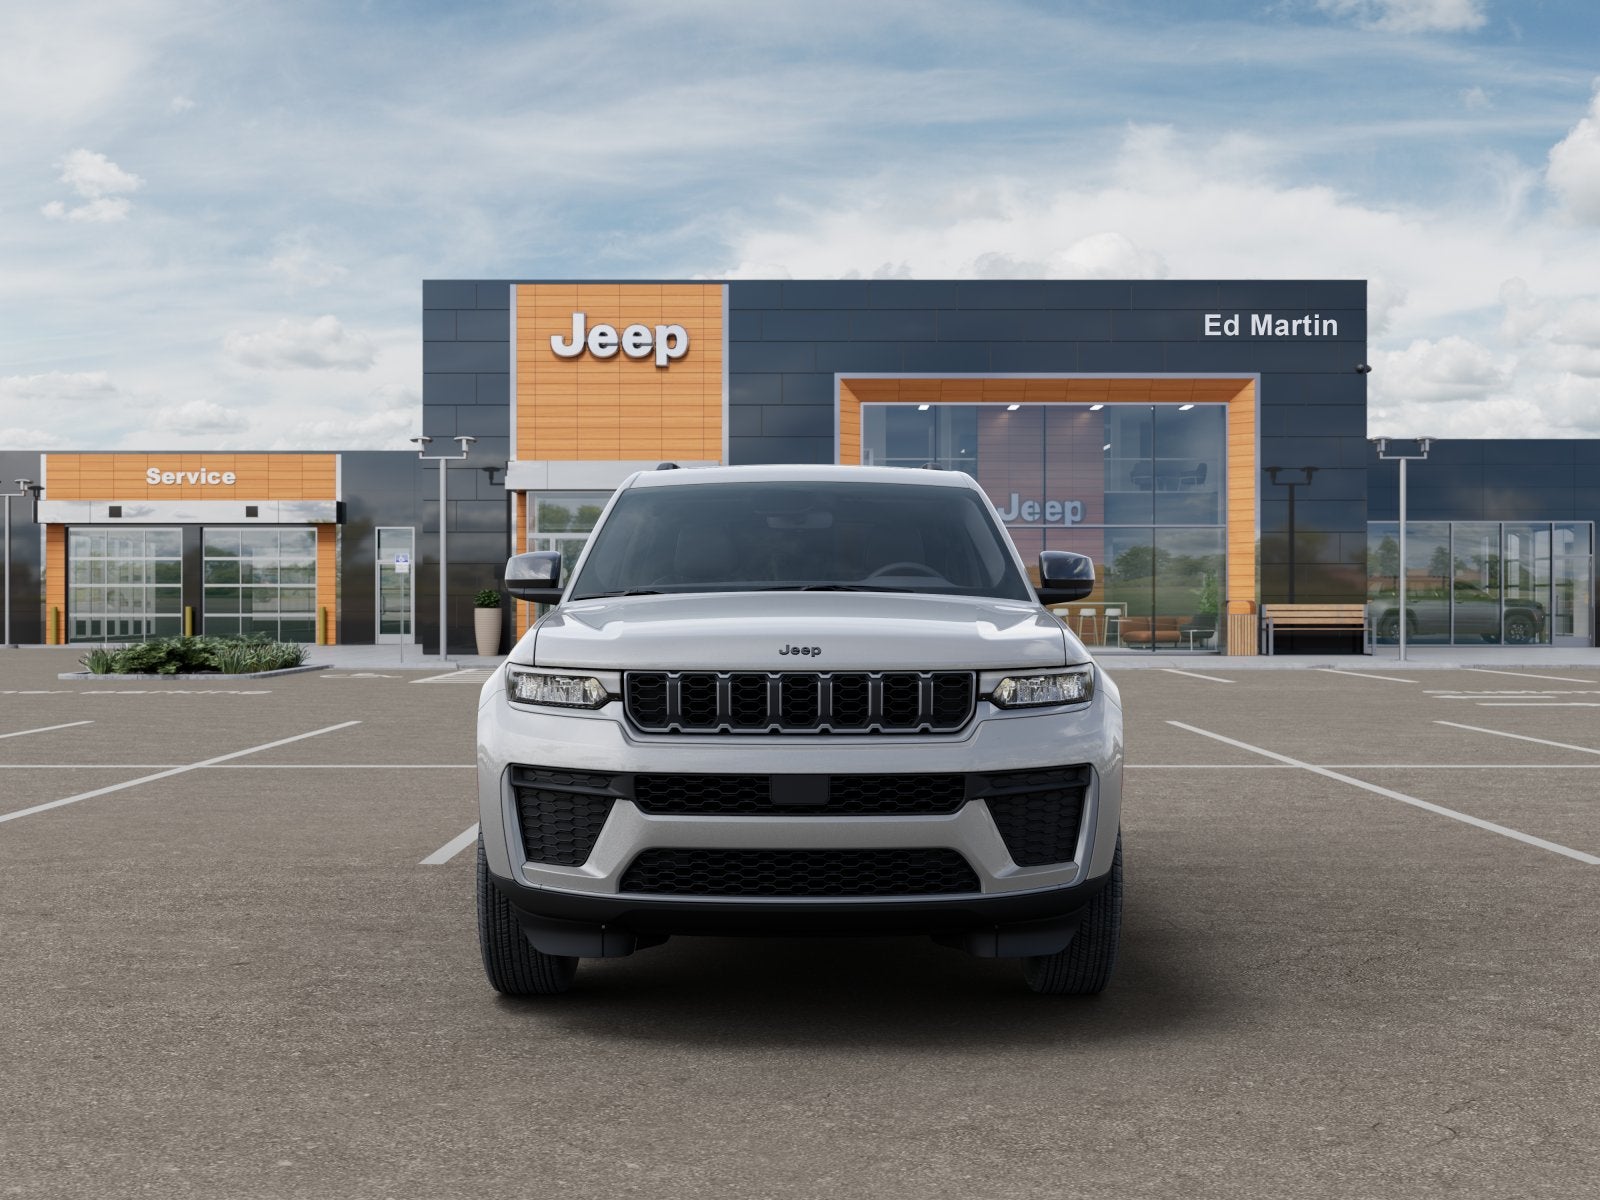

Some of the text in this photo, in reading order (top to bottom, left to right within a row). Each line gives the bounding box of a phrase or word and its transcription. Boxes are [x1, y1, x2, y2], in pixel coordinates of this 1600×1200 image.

[1204, 313, 1338, 336] Ed Martin
[550, 312, 690, 367] Jeep
[146, 467, 237, 485] Service
[997, 493, 1084, 526] Jeep
[779, 644, 822, 657] Jeep
